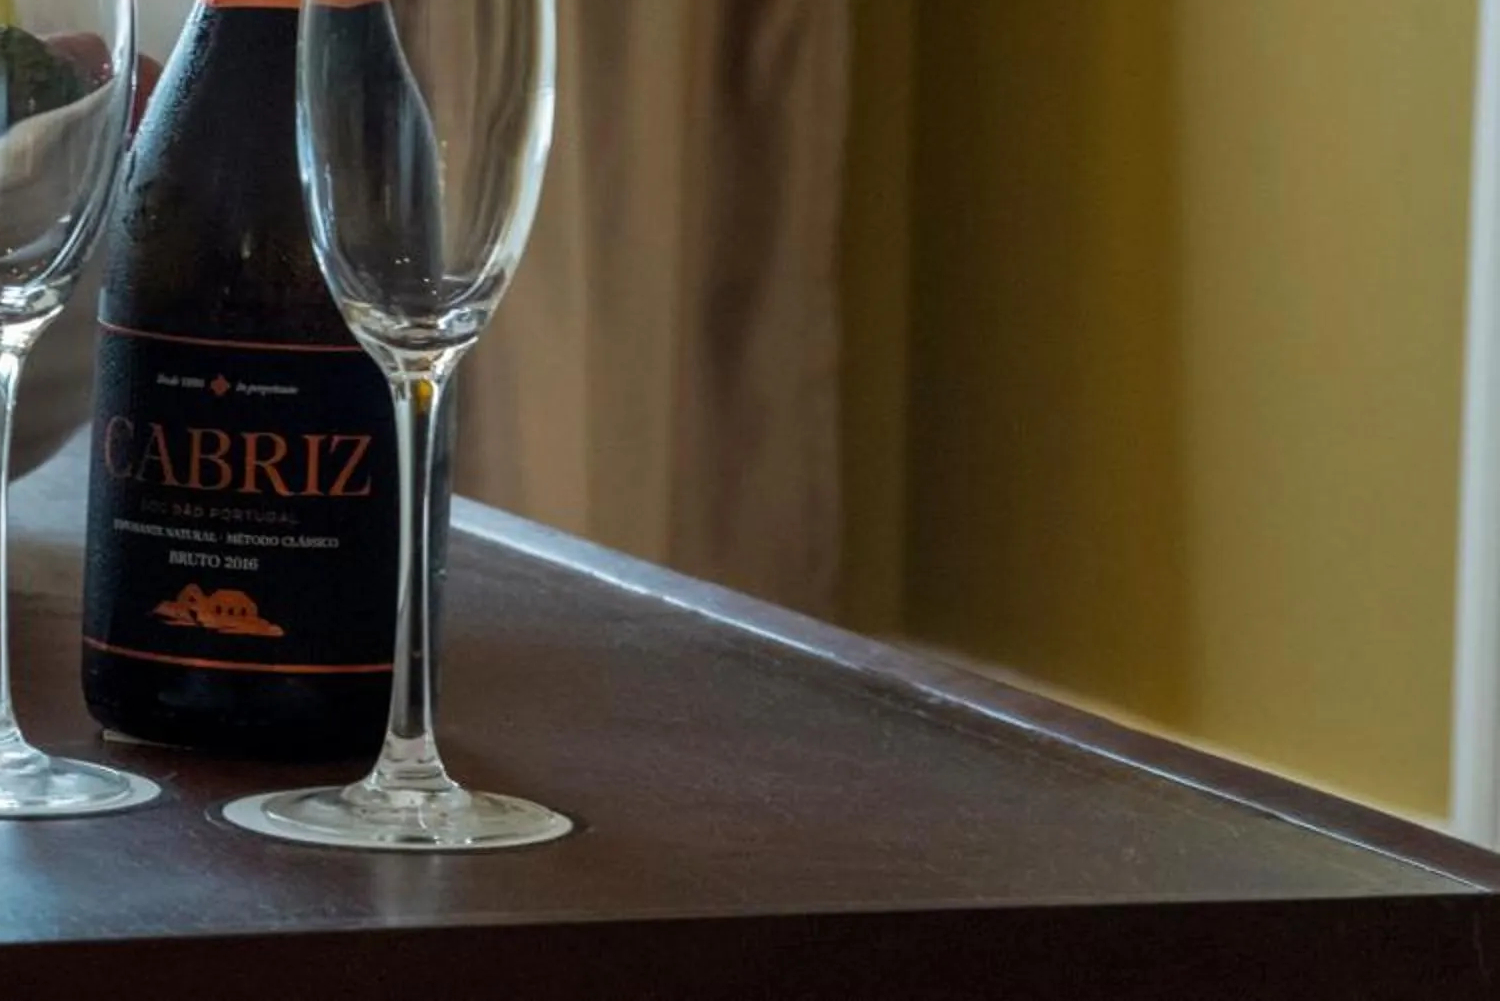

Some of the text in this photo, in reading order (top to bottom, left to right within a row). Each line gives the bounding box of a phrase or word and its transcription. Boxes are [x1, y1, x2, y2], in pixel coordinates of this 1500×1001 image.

[103, 415, 373, 497] CABRIZ
[208, 506, 301, 525] PORTUGAL
[168, 550, 260, 570] BRUTO 2016
